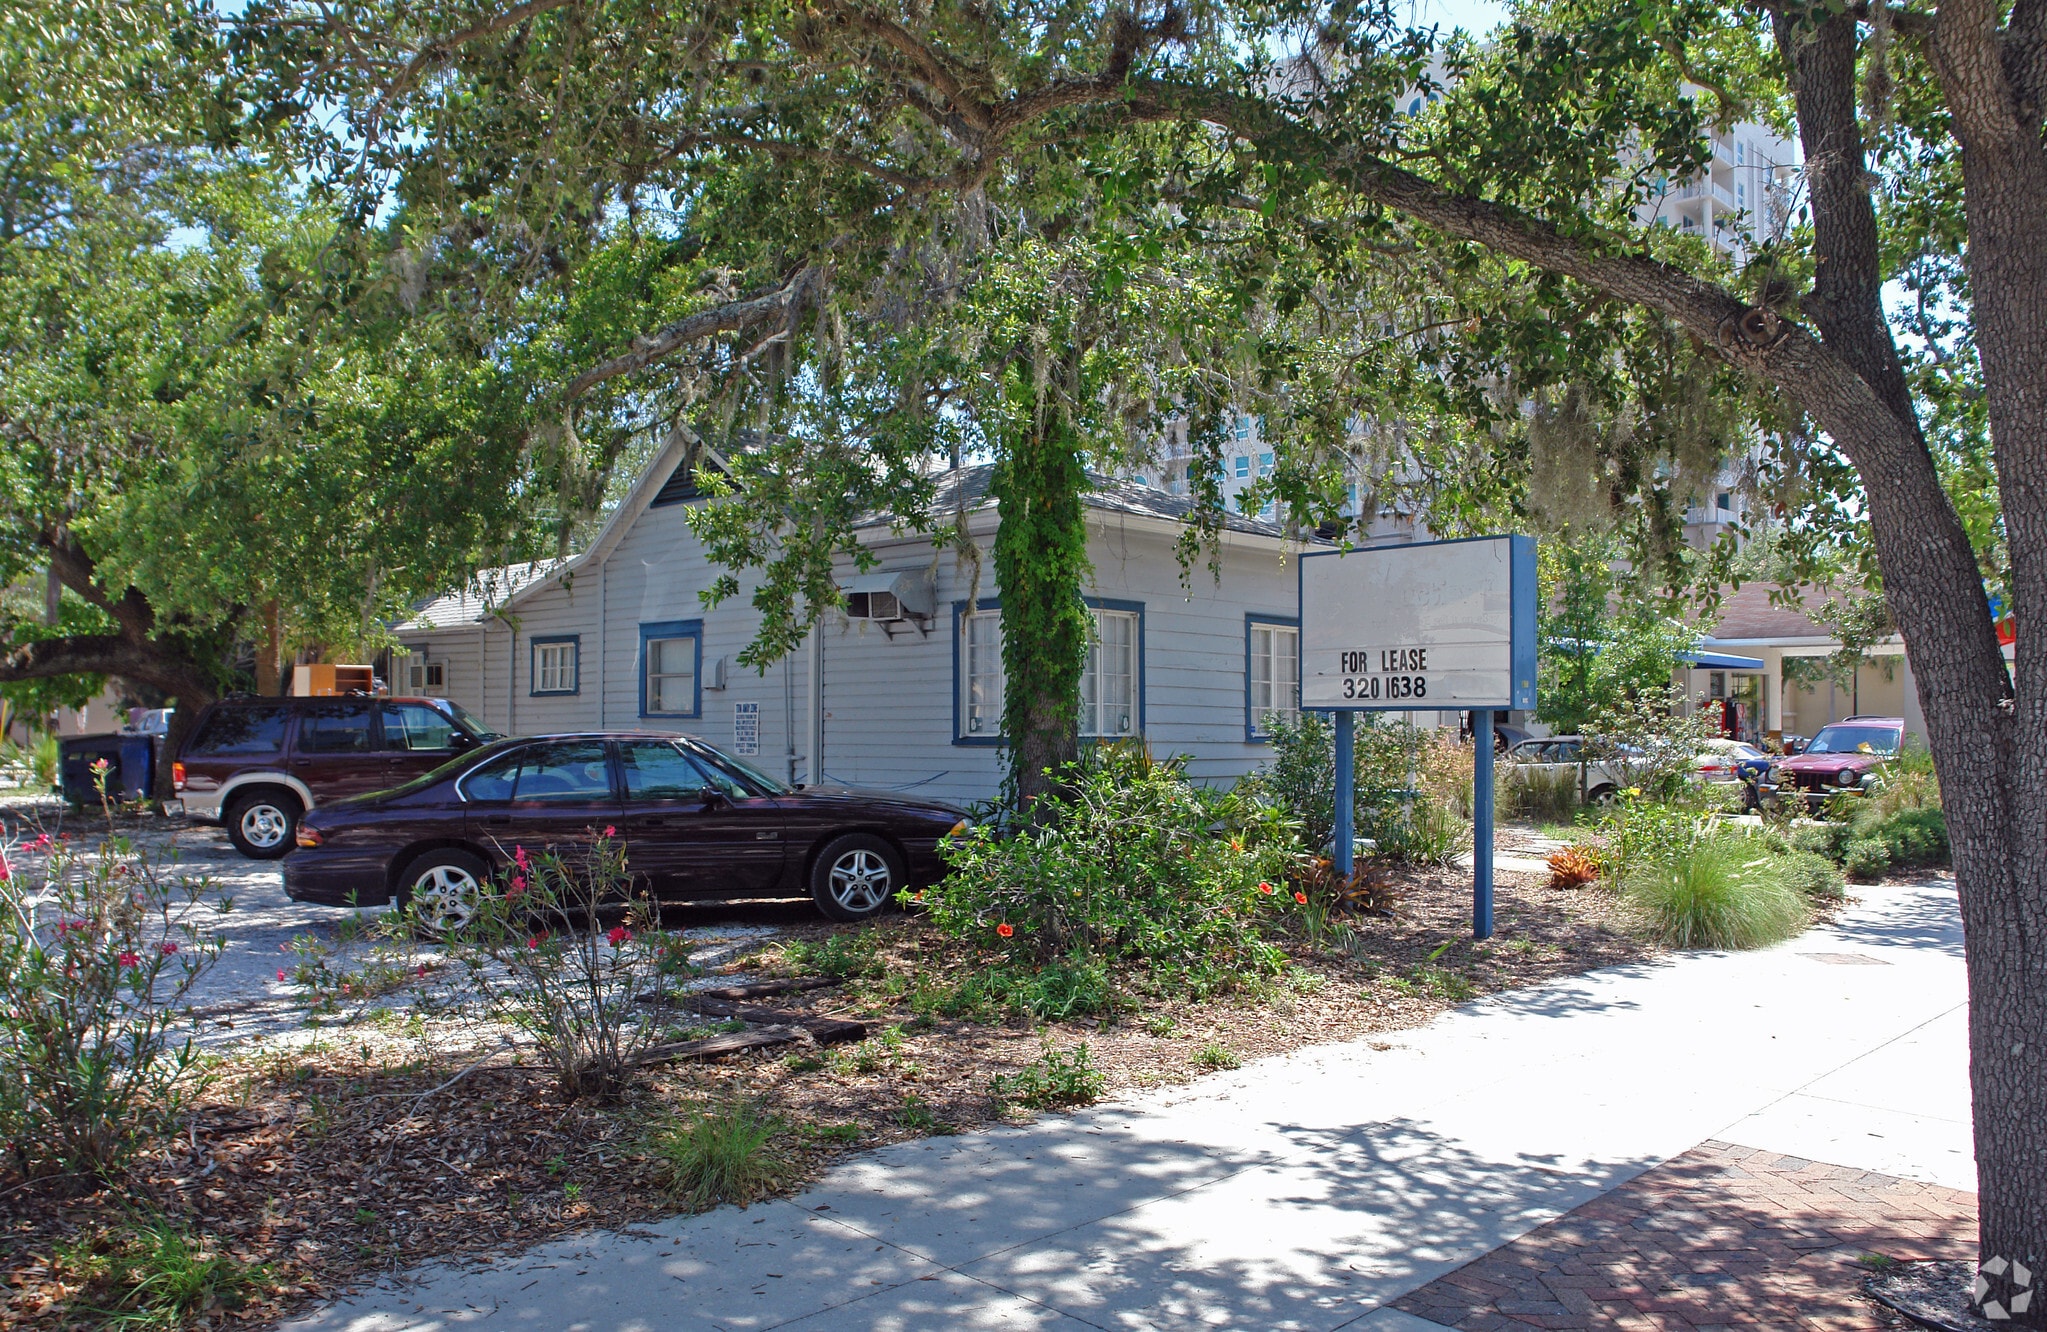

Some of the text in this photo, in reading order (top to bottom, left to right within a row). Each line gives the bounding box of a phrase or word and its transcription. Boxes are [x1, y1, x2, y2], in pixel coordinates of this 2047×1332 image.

[1341, 648, 1427, 673] FOR LEASE
[1343, 676, 1427, 699] 320 1638
